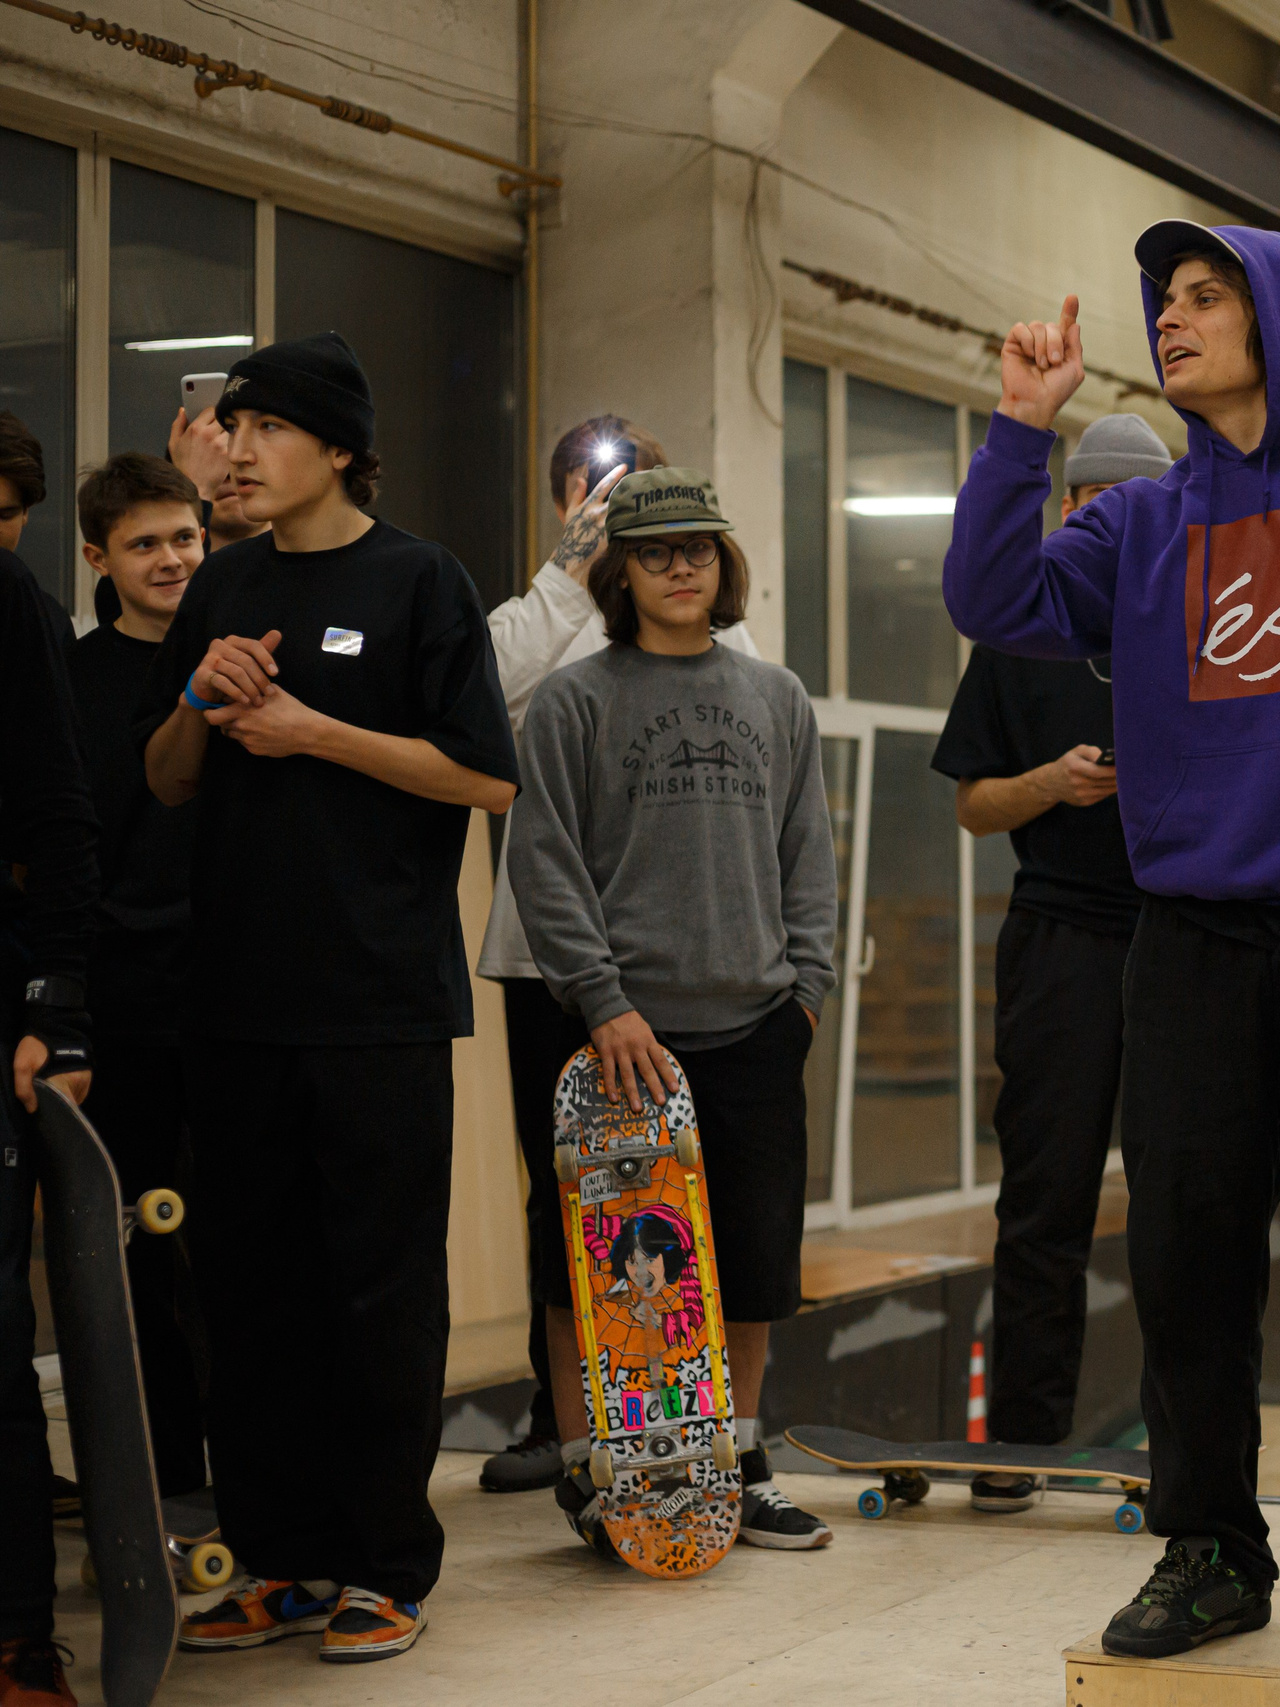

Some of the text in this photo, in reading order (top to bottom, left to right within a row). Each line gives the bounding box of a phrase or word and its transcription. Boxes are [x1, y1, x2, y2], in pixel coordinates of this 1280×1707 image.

[632, 486, 707, 513] THRASHER
[623, 704, 769, 771] START STRONG
[627, 776, 767, 803] FINISH STRON
[583, 1182, 613, 1199] LUNCH
[585, 1174, 600, 1186] OUT
